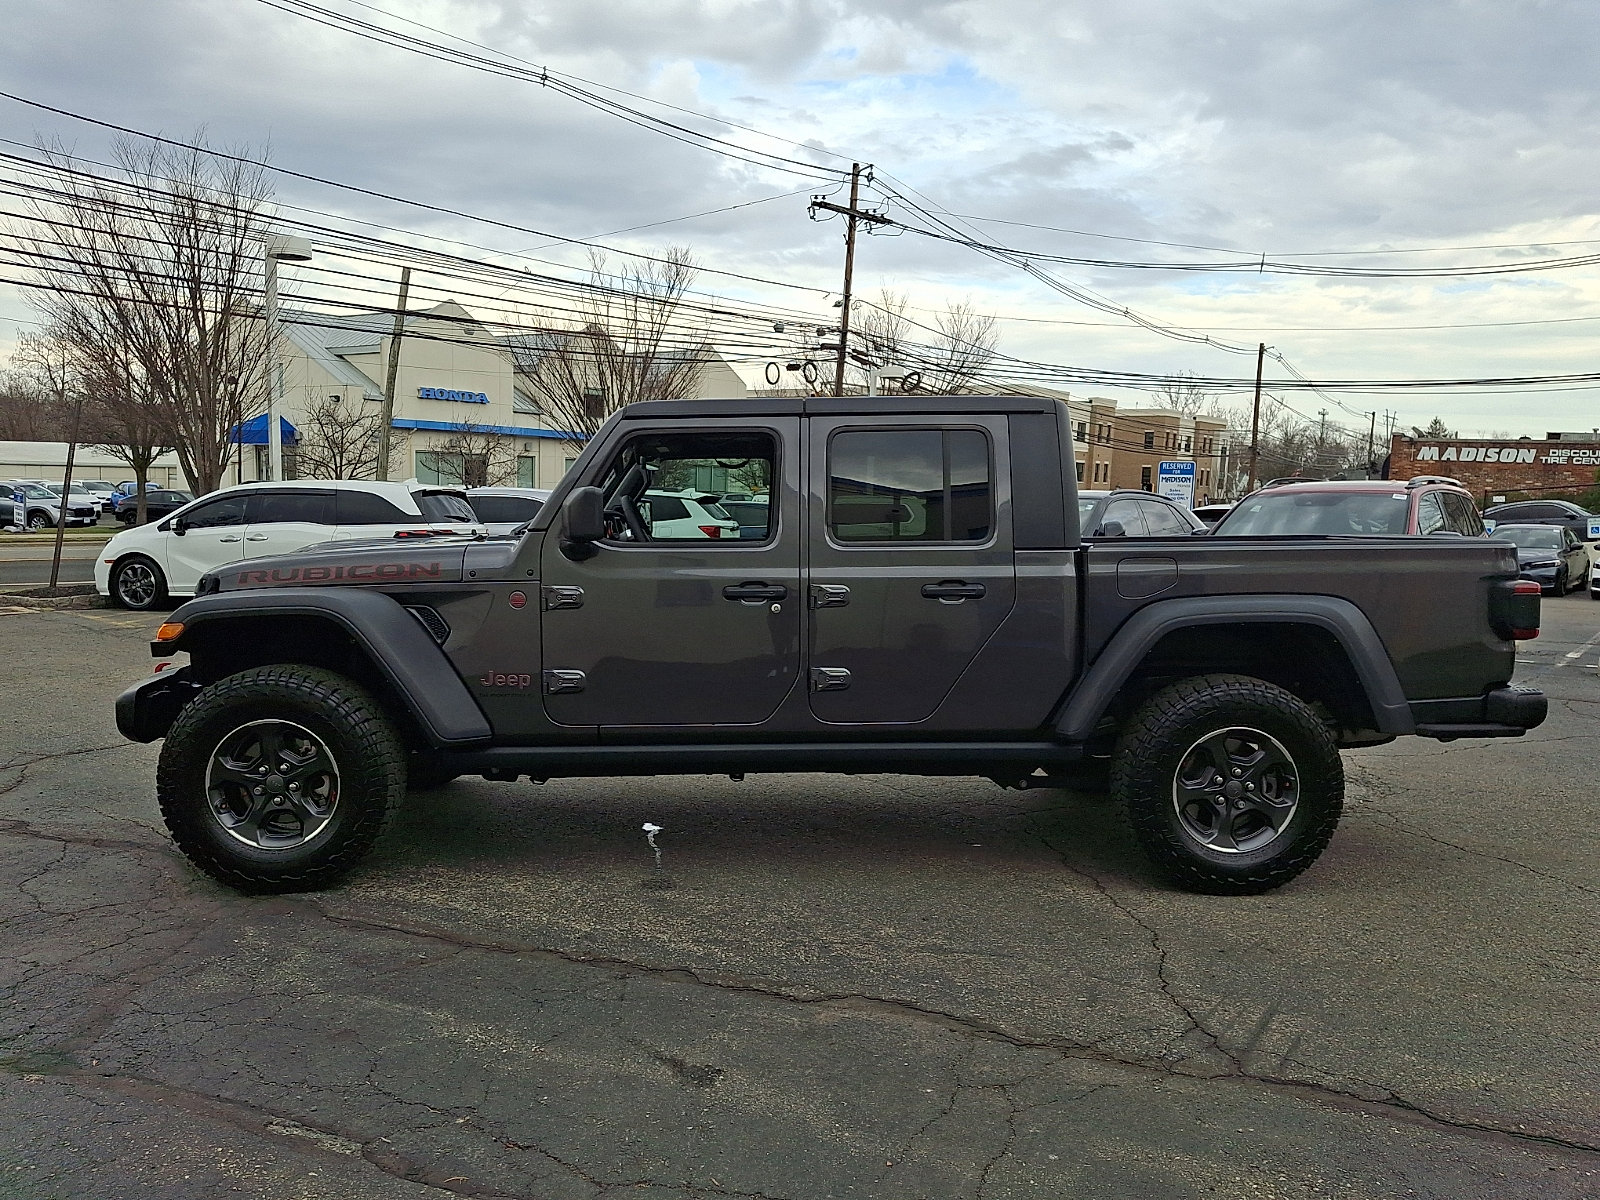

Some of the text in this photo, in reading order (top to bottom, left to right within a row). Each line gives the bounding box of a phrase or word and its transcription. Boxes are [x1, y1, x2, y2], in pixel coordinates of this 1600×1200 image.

[417, 387, 490, 404] HONDA
[1416, 446, 1537, 464] MADISON
[1540, 456, 1568, 464] TIRE
[1549, 449, 1600, 457] DISCOU
[238, 562, 441, 585] RUBICON
[480, 670, 531, 690] Jeep
